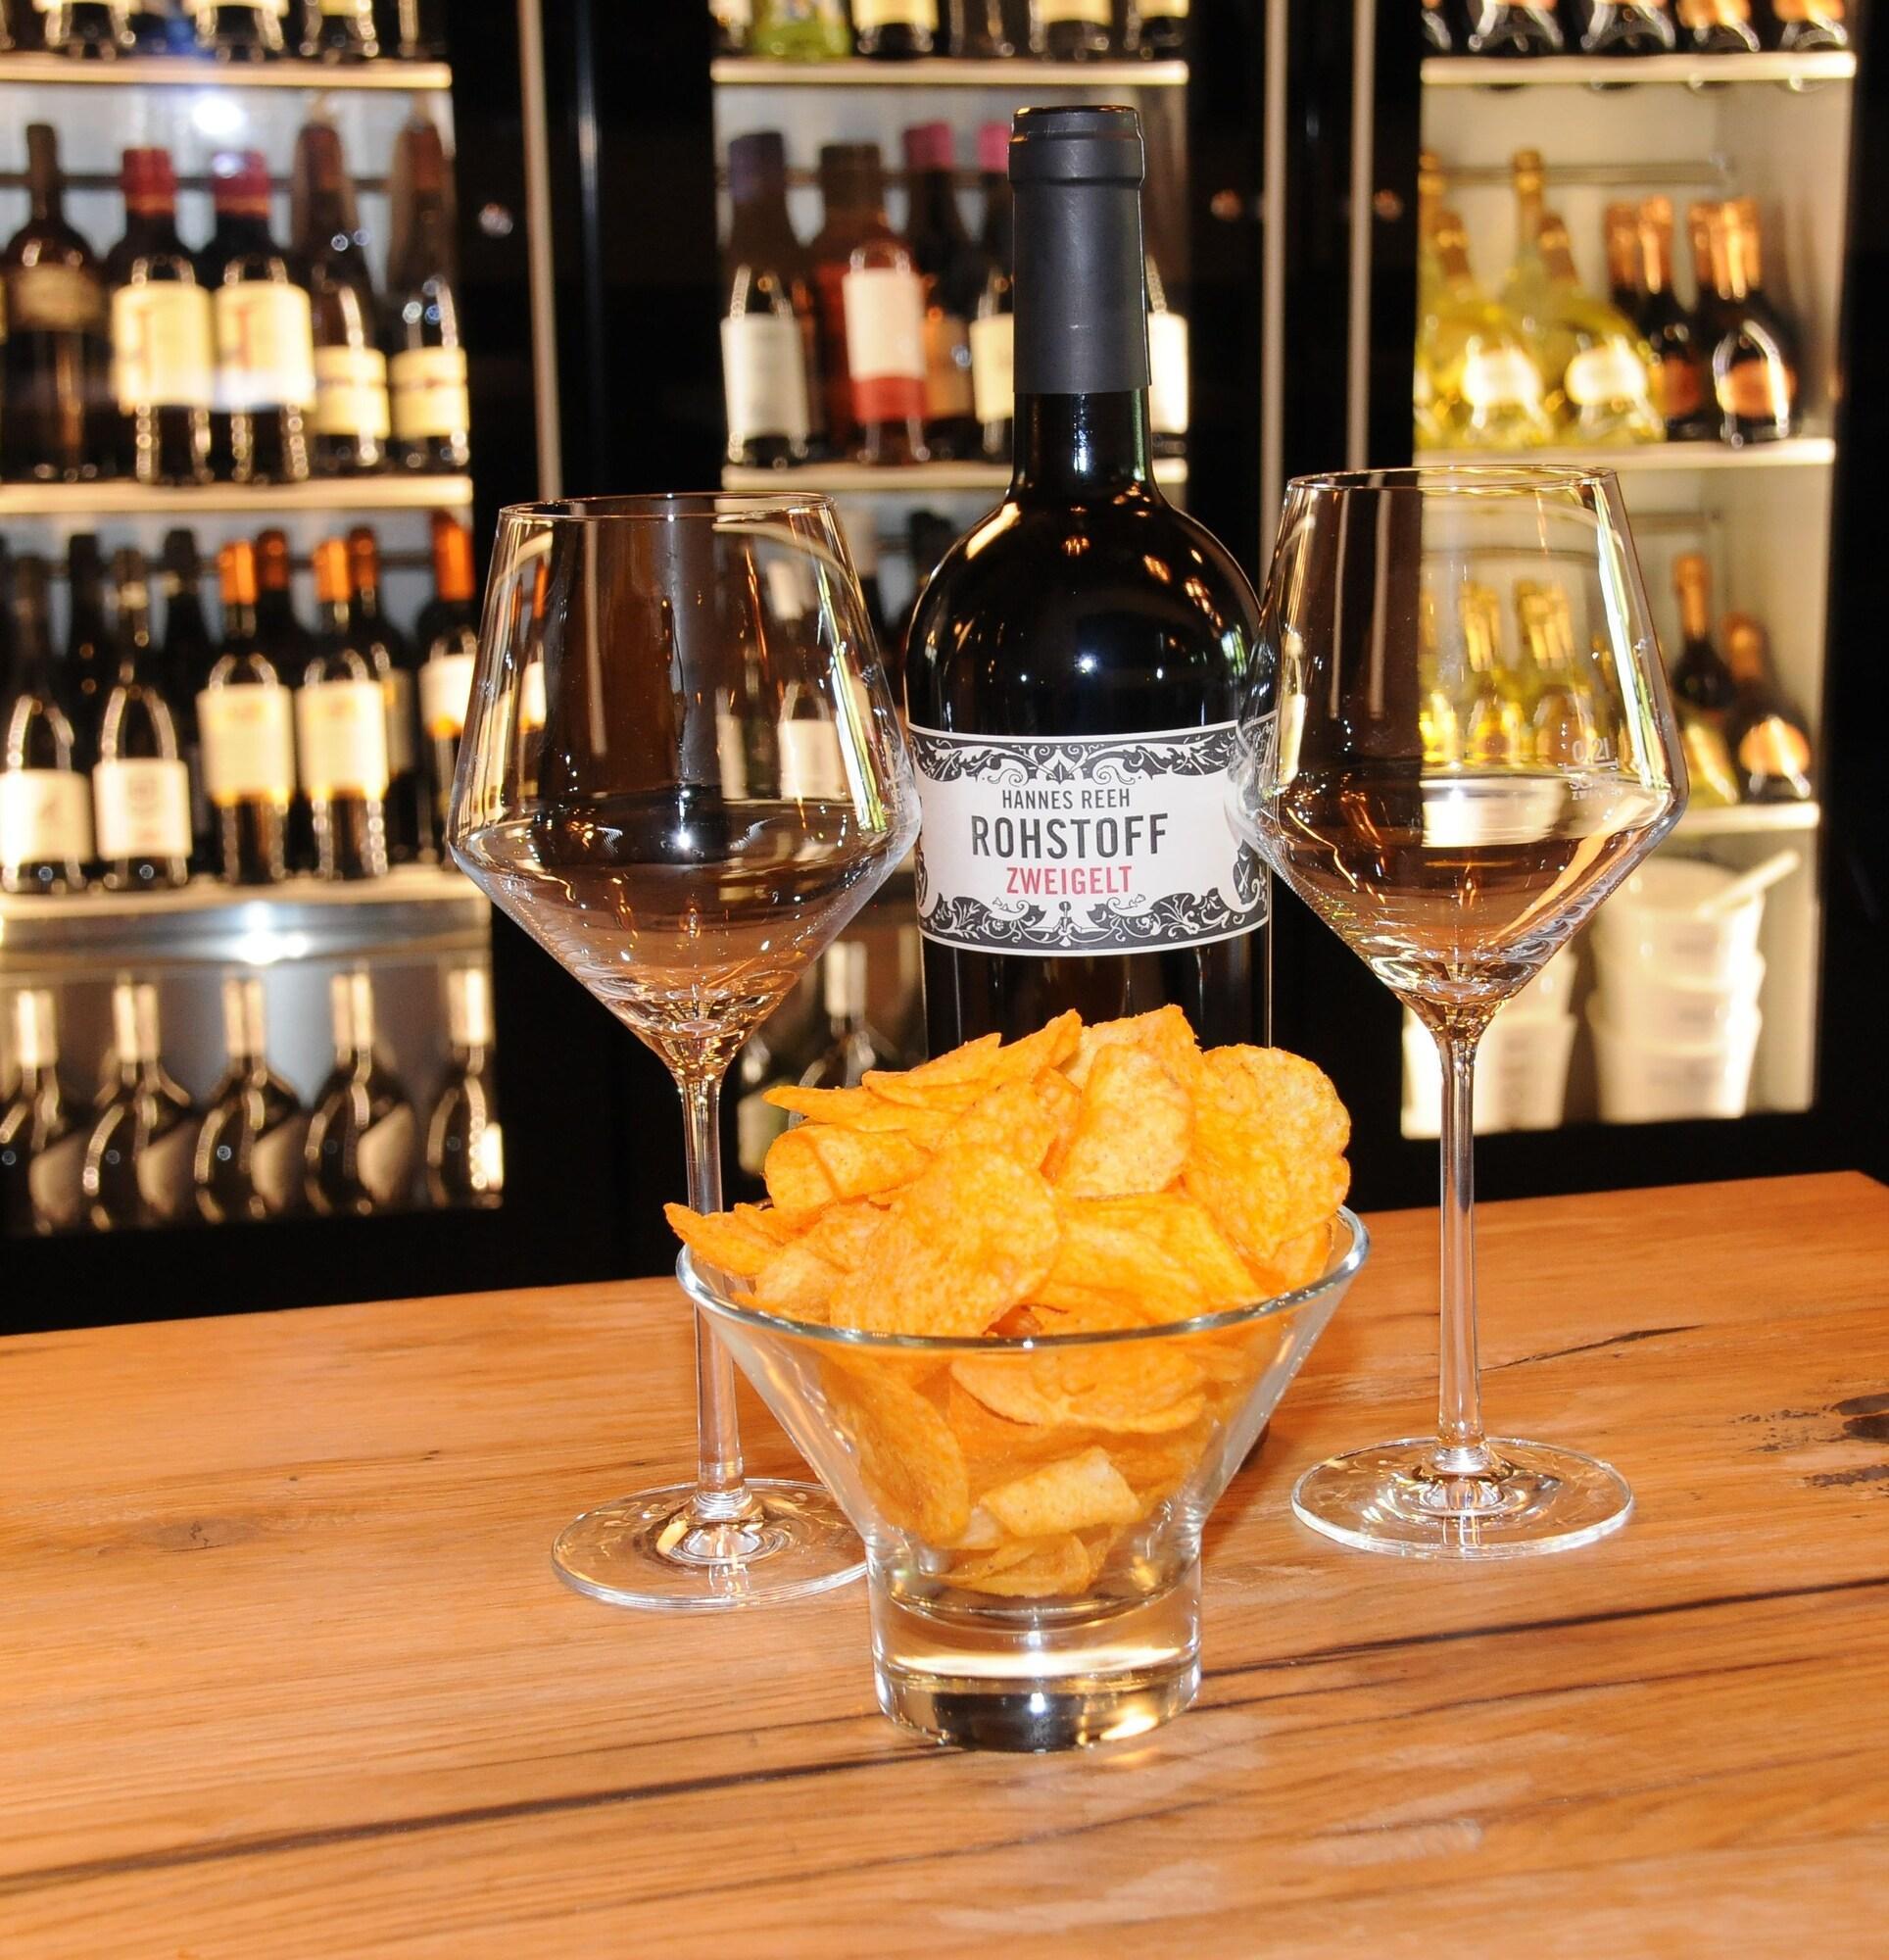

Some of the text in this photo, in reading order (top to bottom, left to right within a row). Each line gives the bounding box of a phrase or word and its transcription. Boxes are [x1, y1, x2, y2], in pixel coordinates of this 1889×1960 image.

[1002, 788, 1131, 809] HANNES REEH
[971, 812, 1169, 859] ROHSTOFF
[1006, 865, 1133, 895] ZWEIGELT
